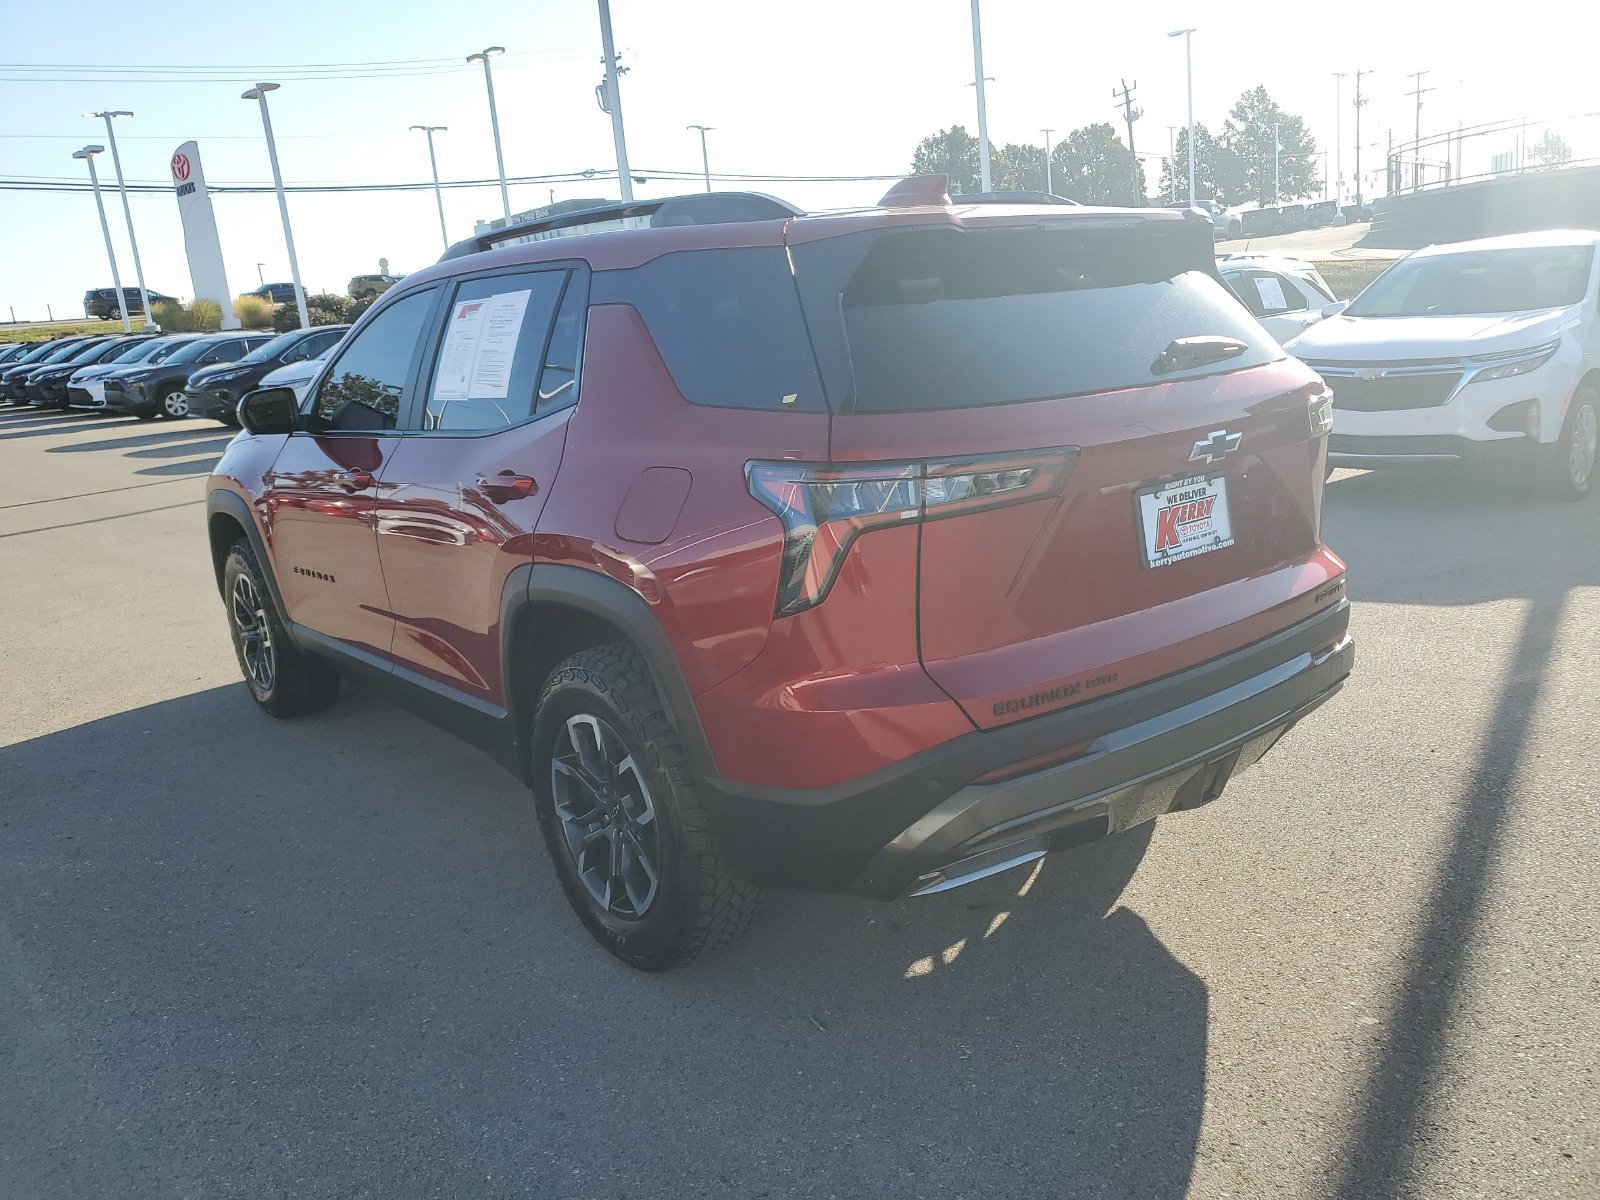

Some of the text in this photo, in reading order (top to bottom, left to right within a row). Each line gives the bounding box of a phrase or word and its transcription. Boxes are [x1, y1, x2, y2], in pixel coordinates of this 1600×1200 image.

[536, 208, 550, 219] BANK
[1164, 475, 1205, 490] RIGHT BY YOU
[1166, 487, 1207, 504] WE DELIVER
[1155, 494, 1218, 553] KERRY
[1188, 520, 1211, 532] TOYOTA
[1149, 538, 1235, 569] kerryautomotive.com
